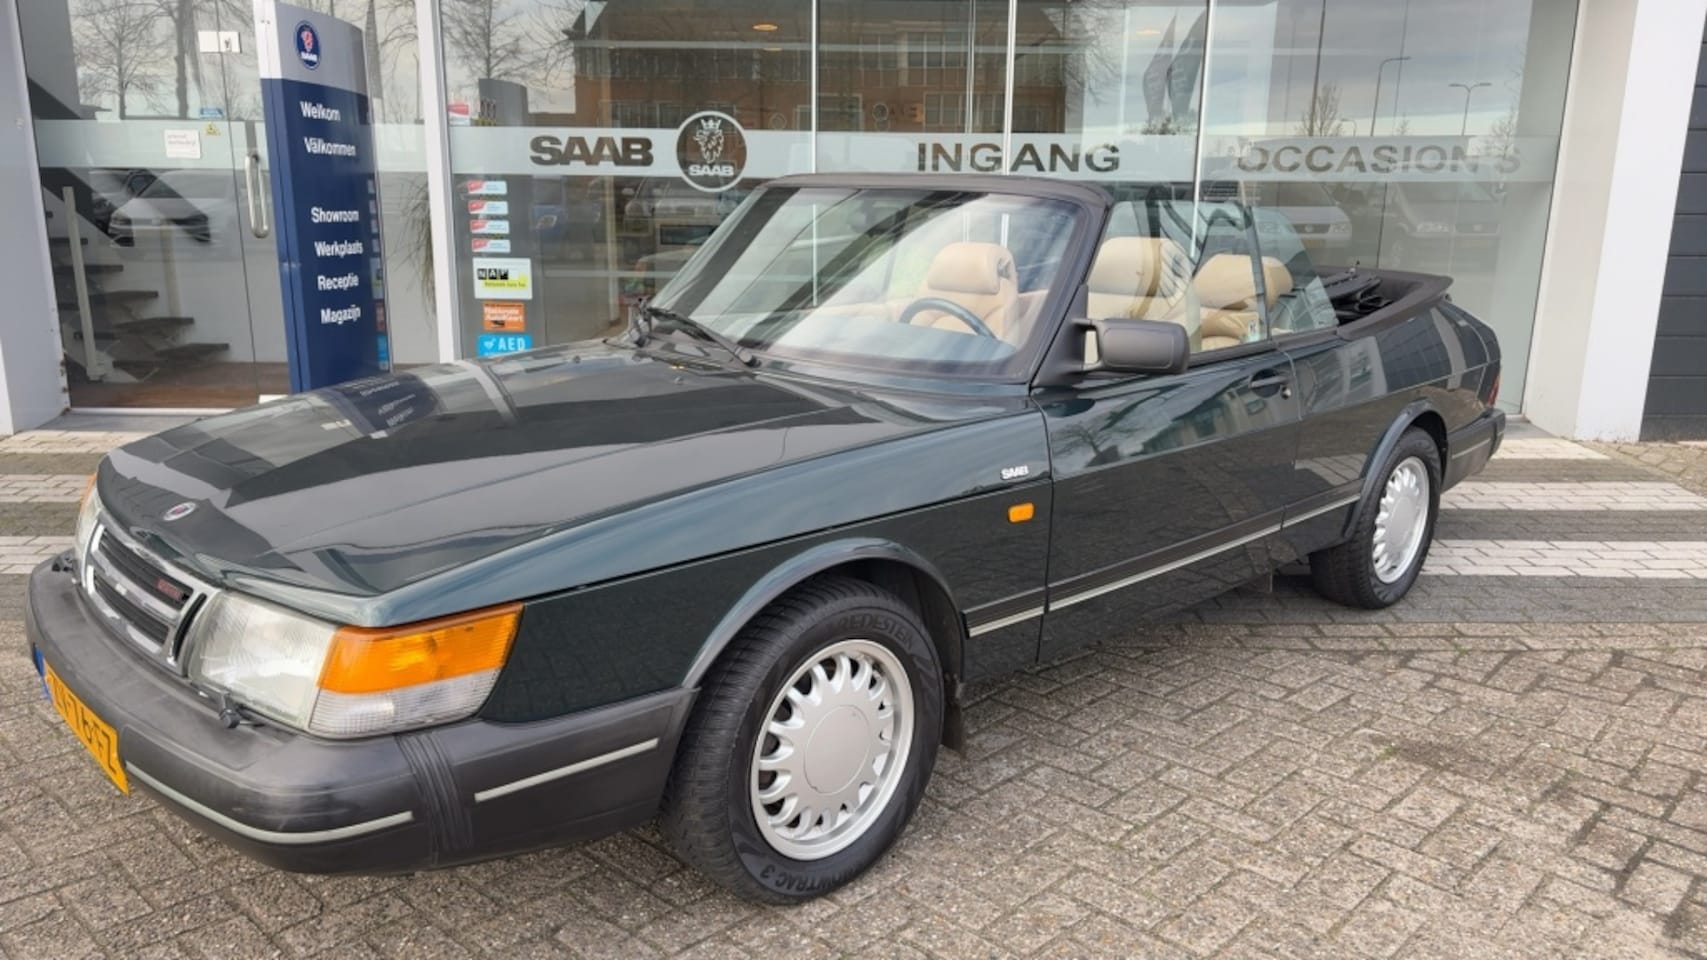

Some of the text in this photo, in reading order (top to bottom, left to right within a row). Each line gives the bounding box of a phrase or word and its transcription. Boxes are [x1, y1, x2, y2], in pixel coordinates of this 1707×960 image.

[299, 101, 341, 121] Welkom
[304, 136, 358, 157] Välkommen
[529, 135, 654, 167] SAAB
[917, 142, 1120, 172] INGANG
[687, 164, 735, 177] SAAB
[310, 206, 360, 223] Showroom
[314, 240, 364, 258] Werkplaats
[317, 272, 359, 291] Receptie
[320, 304, 362, 325] Magazijn
[497, 337, 526, 351] AED
